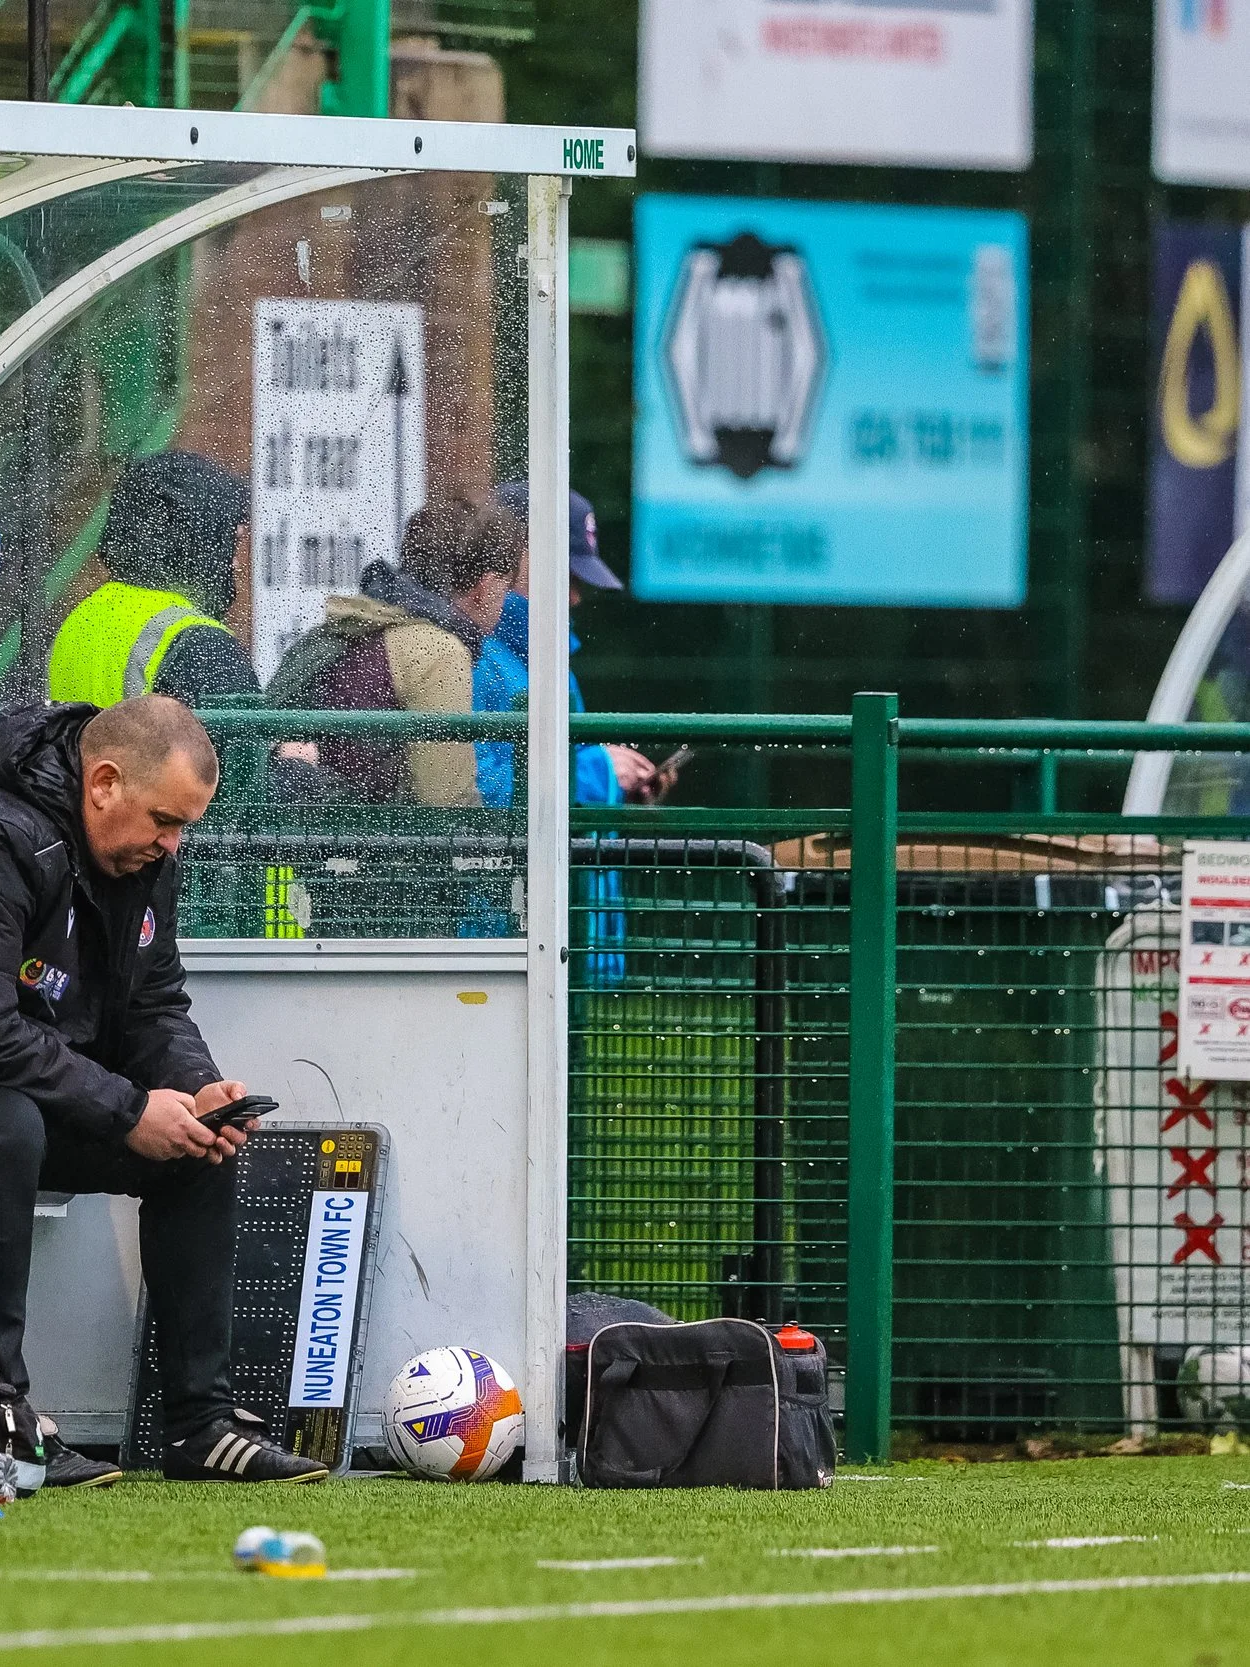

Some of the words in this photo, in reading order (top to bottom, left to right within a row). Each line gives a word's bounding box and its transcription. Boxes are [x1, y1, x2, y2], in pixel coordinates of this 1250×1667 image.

[563, 138, 604, 169] HOME
[323, 1197, 355, 1222] FC
[316, 1229, 351, 1287] TOWN
[302, 1293, 343, 1401] NUNEATON
